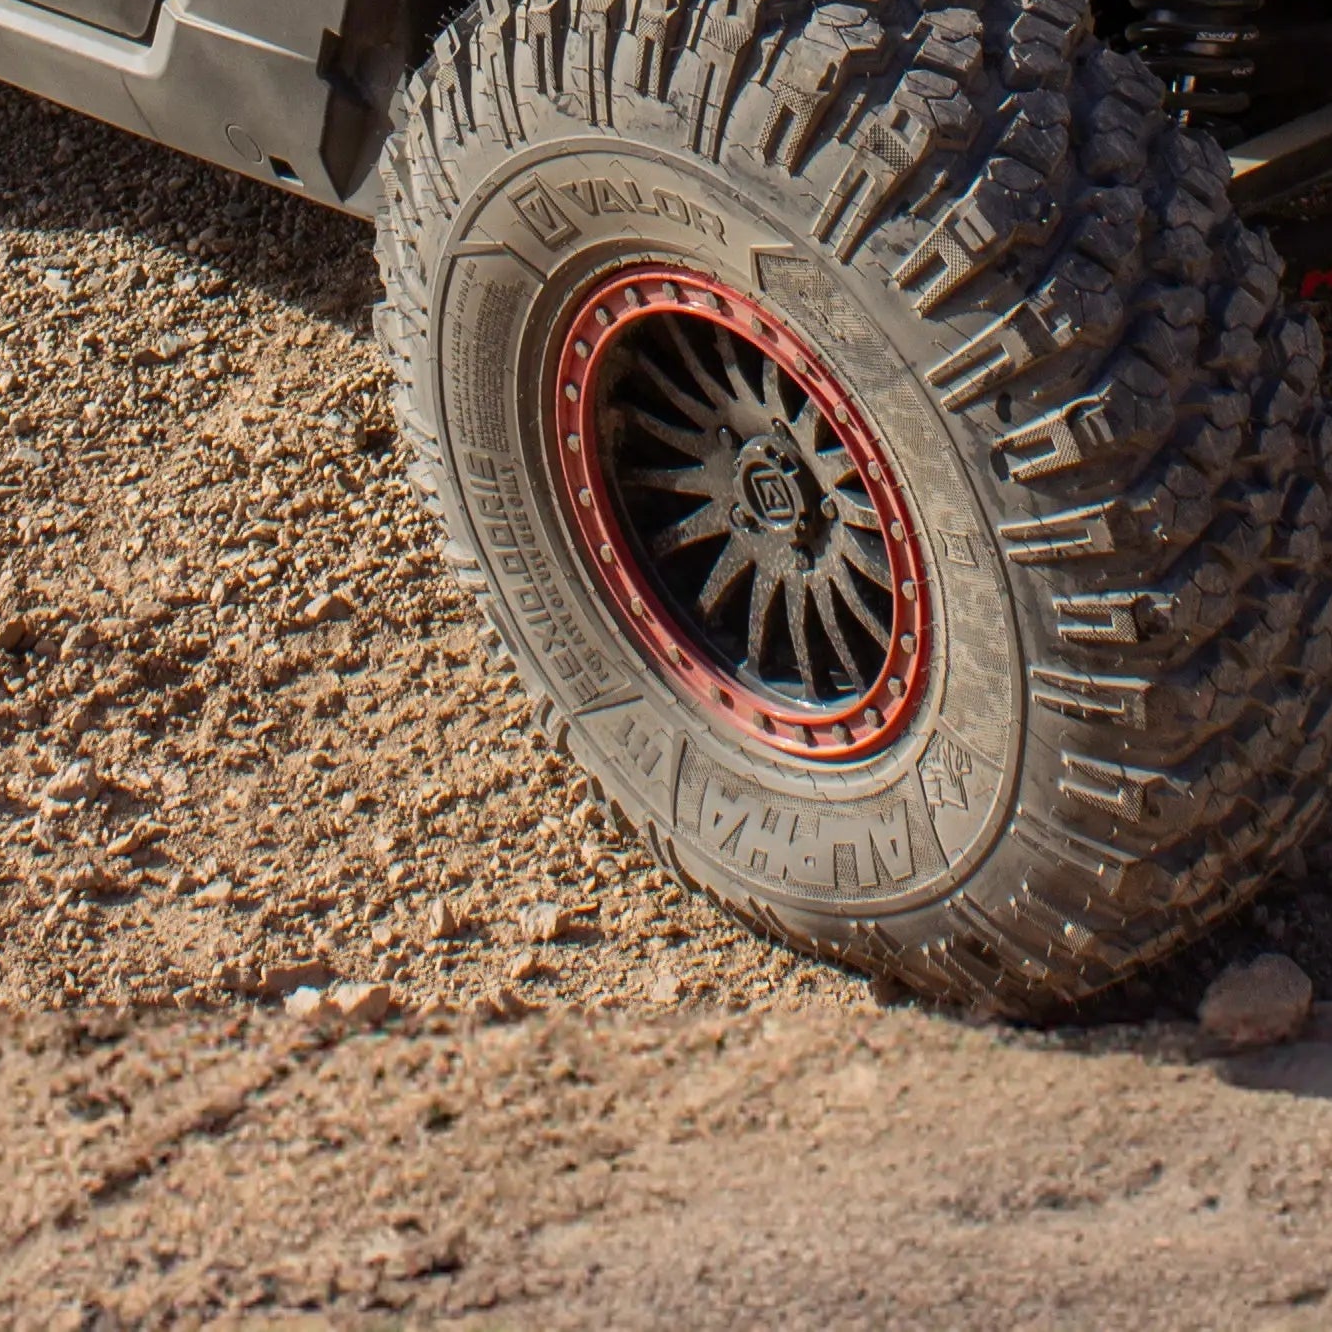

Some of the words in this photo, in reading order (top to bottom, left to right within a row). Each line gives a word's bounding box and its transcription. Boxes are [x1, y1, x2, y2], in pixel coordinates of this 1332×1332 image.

[556, 175, 729, 247] VALOR
[499, 462, 524, 508] ONLY
[514, 510, 536, 544] USE
[544, 586, 565, 610] OR
[558, 611, 587, 647] ATV
[697, 777, 913, 888] ALPHA
